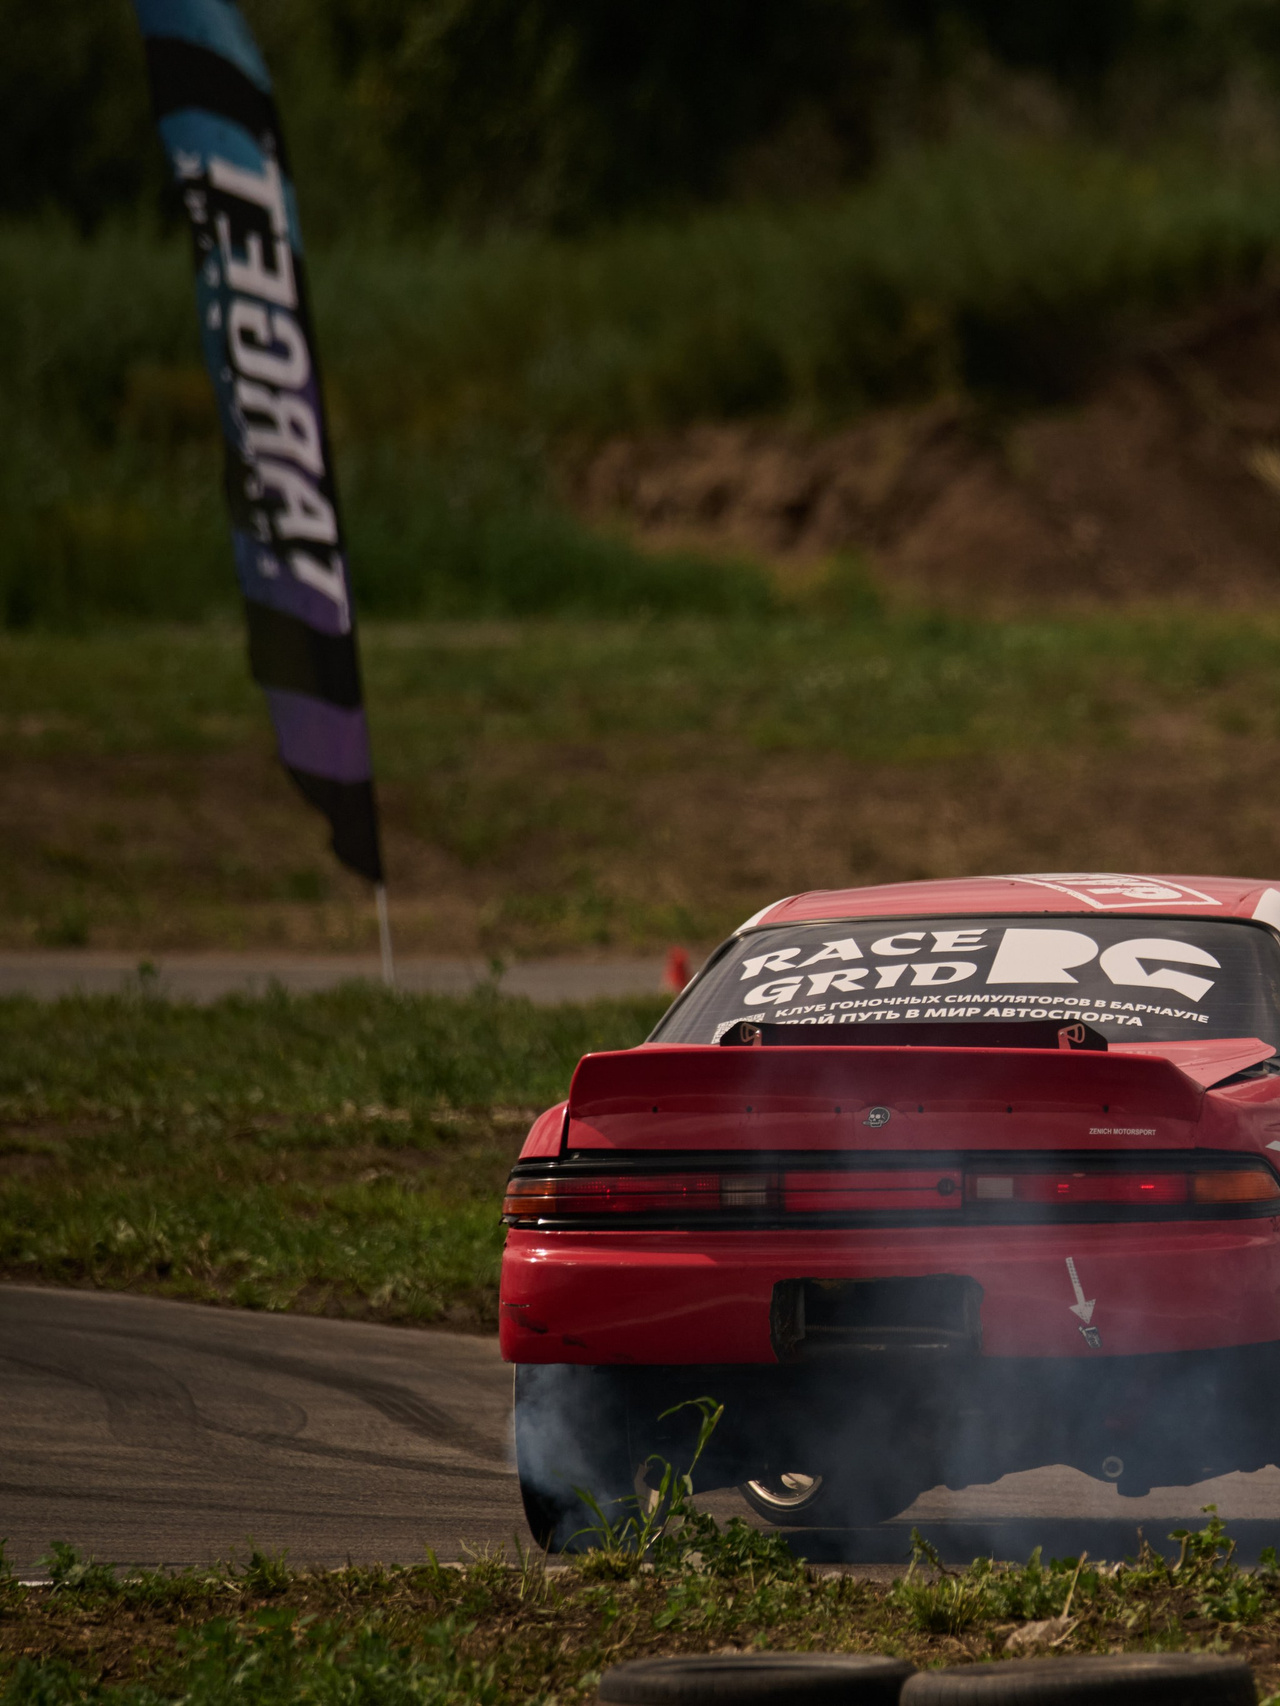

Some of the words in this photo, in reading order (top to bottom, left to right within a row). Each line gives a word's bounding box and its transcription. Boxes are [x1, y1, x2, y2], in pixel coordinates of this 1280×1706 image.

[739, 928, 988, 980] RACE
[743, 961, 978, 1006] GRID
[775, 1003, 826, 1018] КЛУБ
[829, 994, 941, 1011] ГОНОЧНЫХ
[950, 994, 1091, 1007] СИМУЛЯТОРОВ
[1094, 999, 1107, 1008] В
[1109, 1001, 1210, 1024] БАРНАУЛЕ
[839, 1009, 902, 1023] ПУТЬ
[904, 1008, 921, 1018] В
[923, 1007, 981, 1018] МИР
[983, 1007, 1143, 1026] АВТОСПОРТА
[1113, 1128, 1157, 1136] MOTORSPORT
